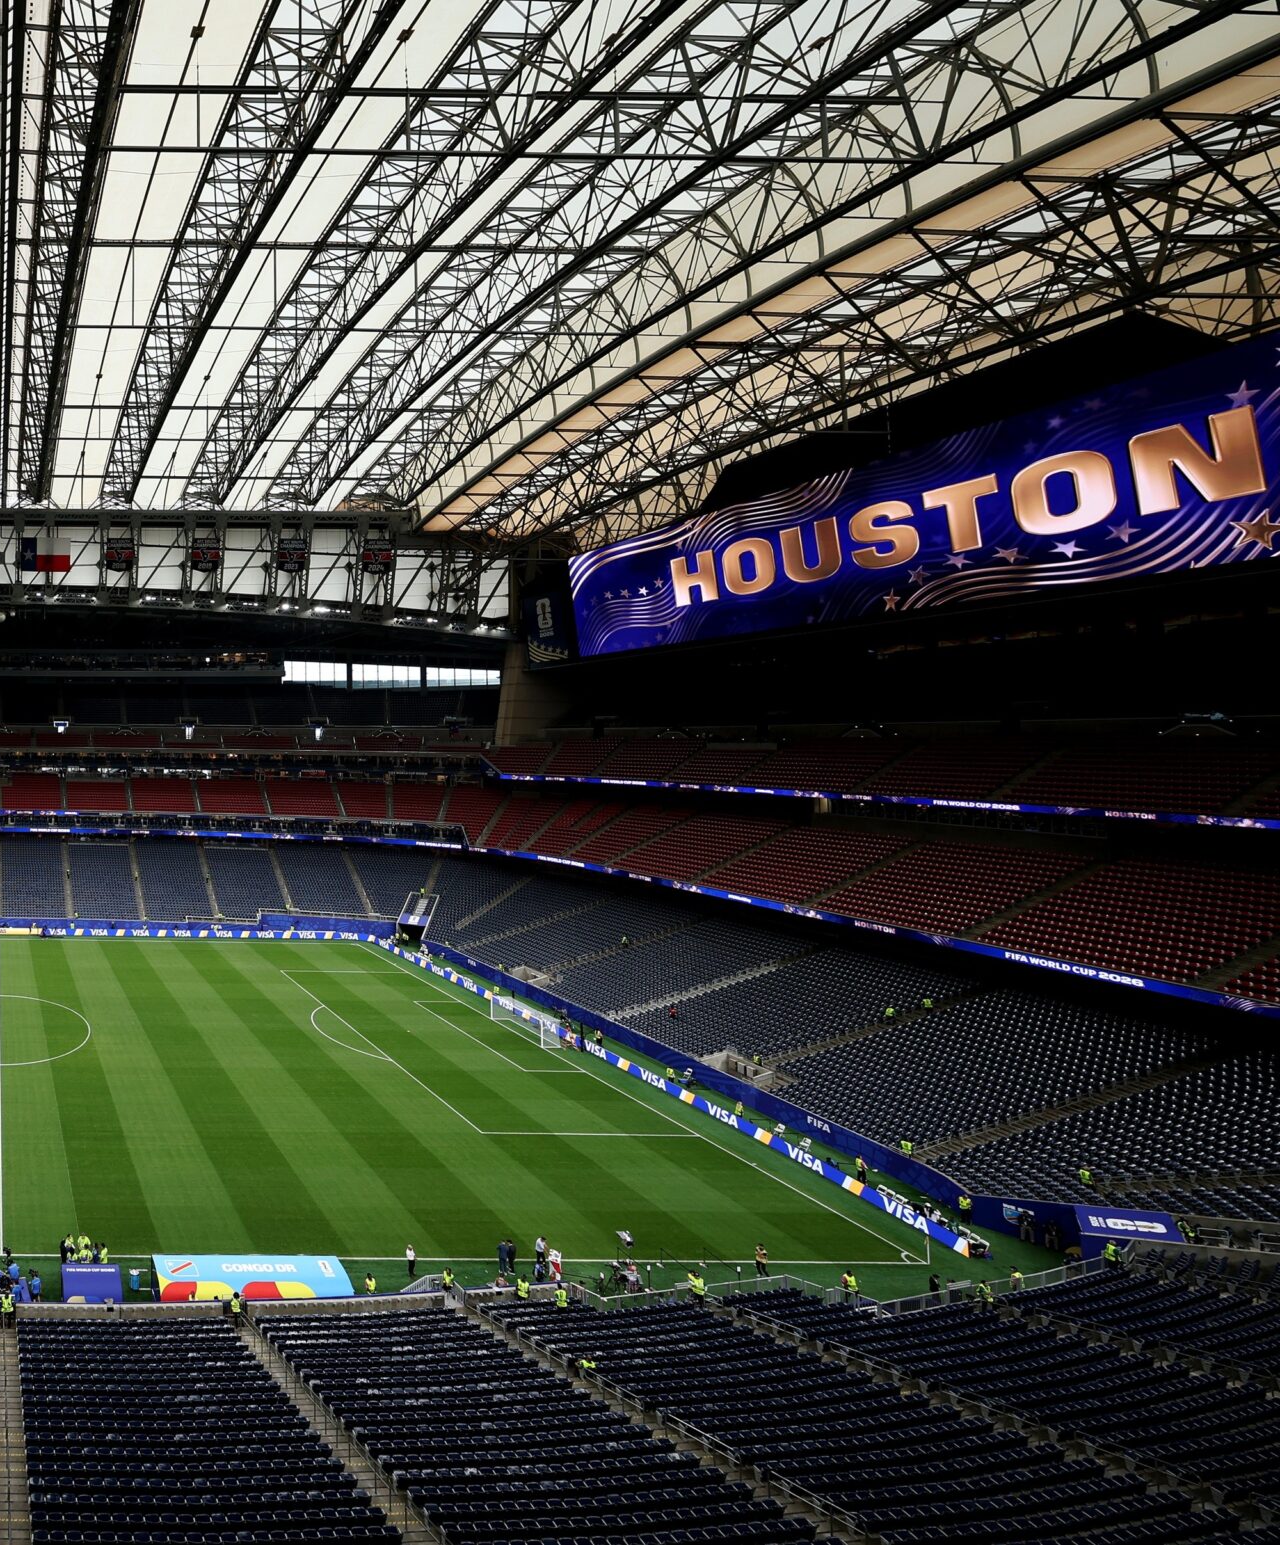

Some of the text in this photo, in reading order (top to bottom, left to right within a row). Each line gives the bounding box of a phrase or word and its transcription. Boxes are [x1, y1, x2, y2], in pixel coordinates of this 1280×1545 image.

[668, 403, 1267, 608] HOUSTON
[841, 793, 873, 801] HOUSTON
[949, 800, 976, 808] WORLD
[992, 803, 1020, 811] 2026
[1104, 810, 1157, 820] HOUSTON
[49, 928, 67, 936] VISA
[854, 919, 896, 934] HOUSTON
[90, 929, 108, 937] VISA
[131, 929, 150, 937] VISA
[173, 930, 191, 938] VISA
[214, 930, 233, 938] VISA
[256, 931, 275, 939] VISA
[297, 931, 317, 939] VISA
[339, 932, 359, 940] VISA
[402, 950, 416, 963] VISA
[431, 963, 445, 977] VISA
[1004, 950, 1146, 988] FIFA WORLD CUP 2026
[463, 978, 478, 993] VISA
[583, 1038, 607, 1060] VISA
[637, 1066, 667, 1091] VISA
[704, 1099, 739, 1129] VISA
[807, 1114, 831, 1134] FIFA
[784, 1140, 824, 1176] VISA
[880, 1193, 930, 1236] VISA
[221, 1263, 299, 1273] CONGO DR
